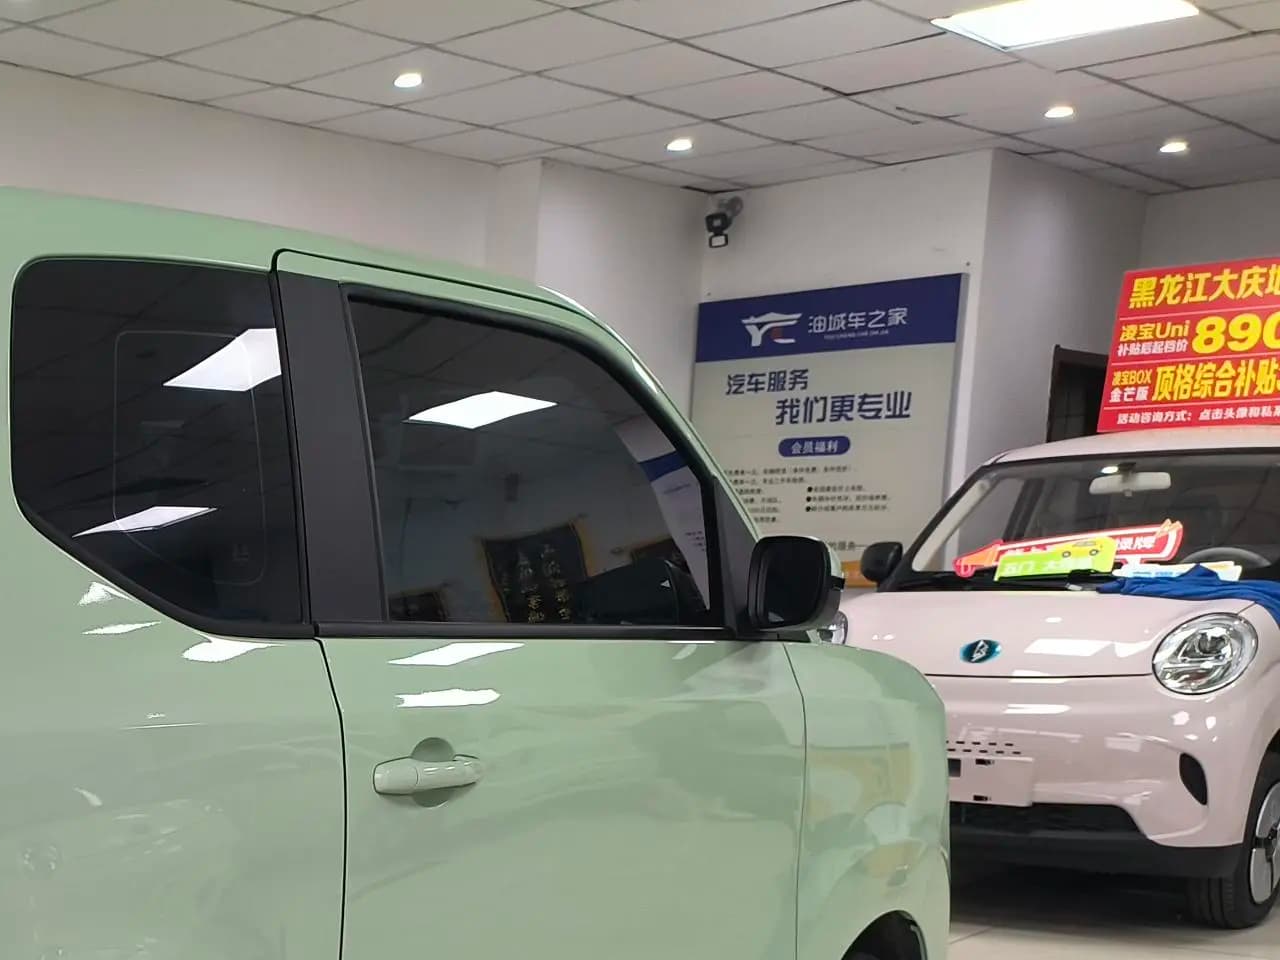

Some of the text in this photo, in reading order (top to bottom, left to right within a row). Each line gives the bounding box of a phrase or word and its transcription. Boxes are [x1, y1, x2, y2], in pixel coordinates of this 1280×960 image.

[808, 307, 908, 334] 油城车之家
[1120, 320, 1191, 342] 凌宝Uni
[1117, 339, 1188, 357] 补贴后起档价
[726, 368, 809, 396] 汽车服务
[1112, 369, 1153, 386] 凌宝BOX
[1152, 357, 1280, 401] 顶格综合补贴
[775, 390, 912, 426] 我们更专业
[791, 440, 838, 454] 会员福利
